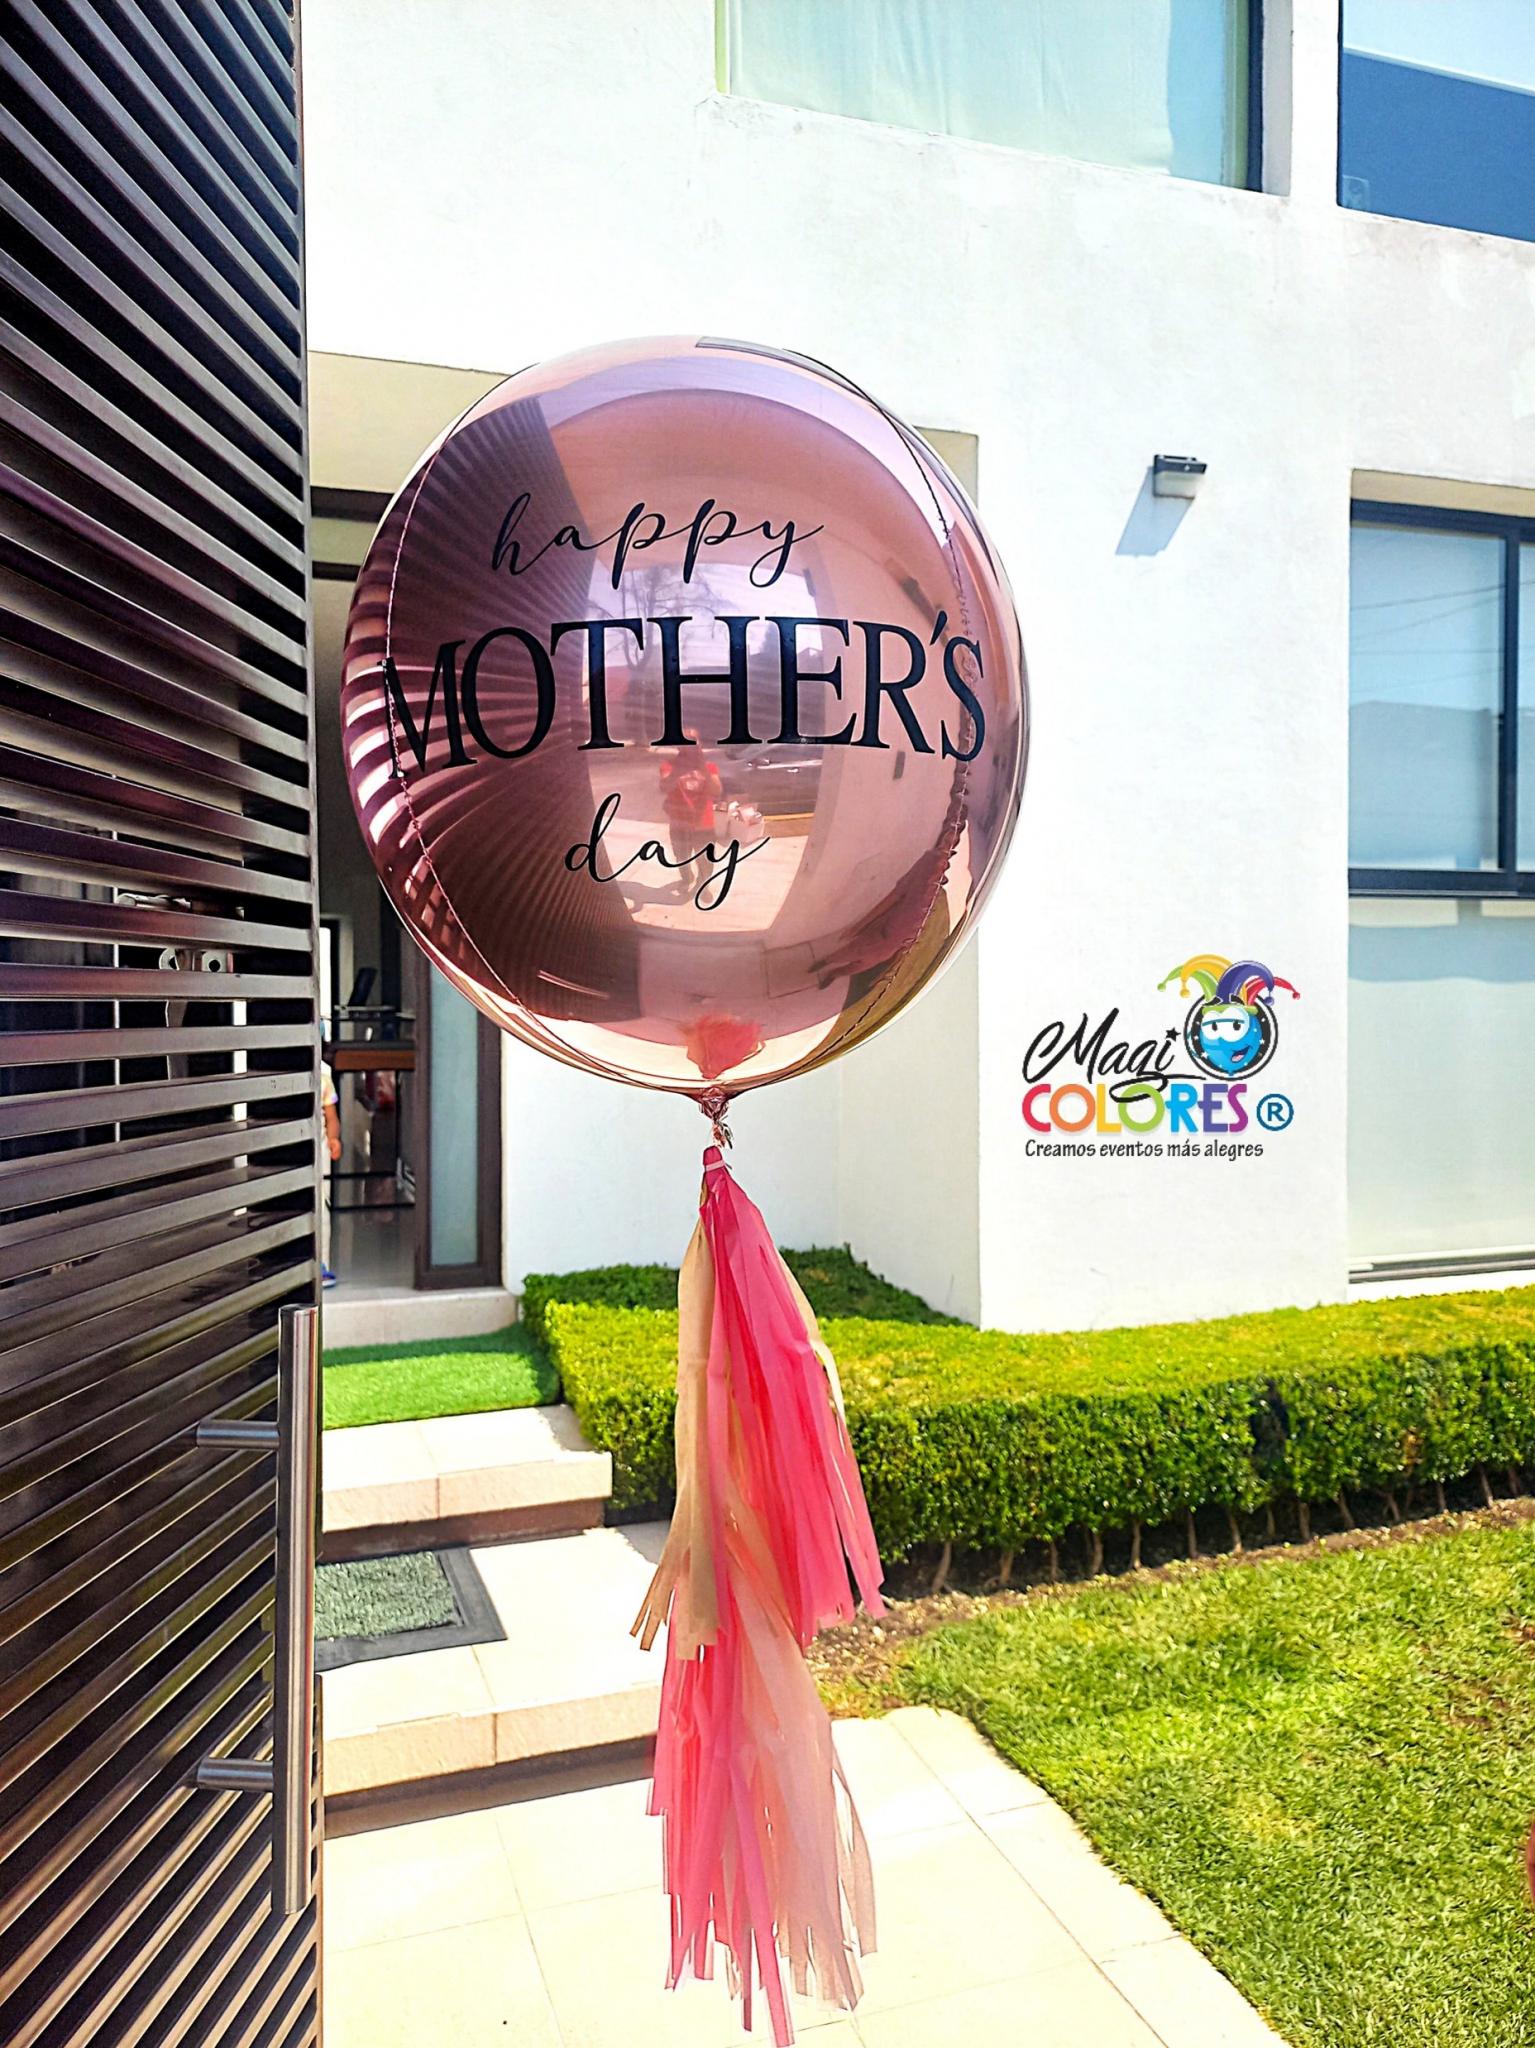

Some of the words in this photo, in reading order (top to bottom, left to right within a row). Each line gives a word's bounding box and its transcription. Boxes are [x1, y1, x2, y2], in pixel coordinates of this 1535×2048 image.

[492, 493, 824, 589] happy
[377, 612, 985, 779] MOTHER'S
[564, 792, 770, 911] day
